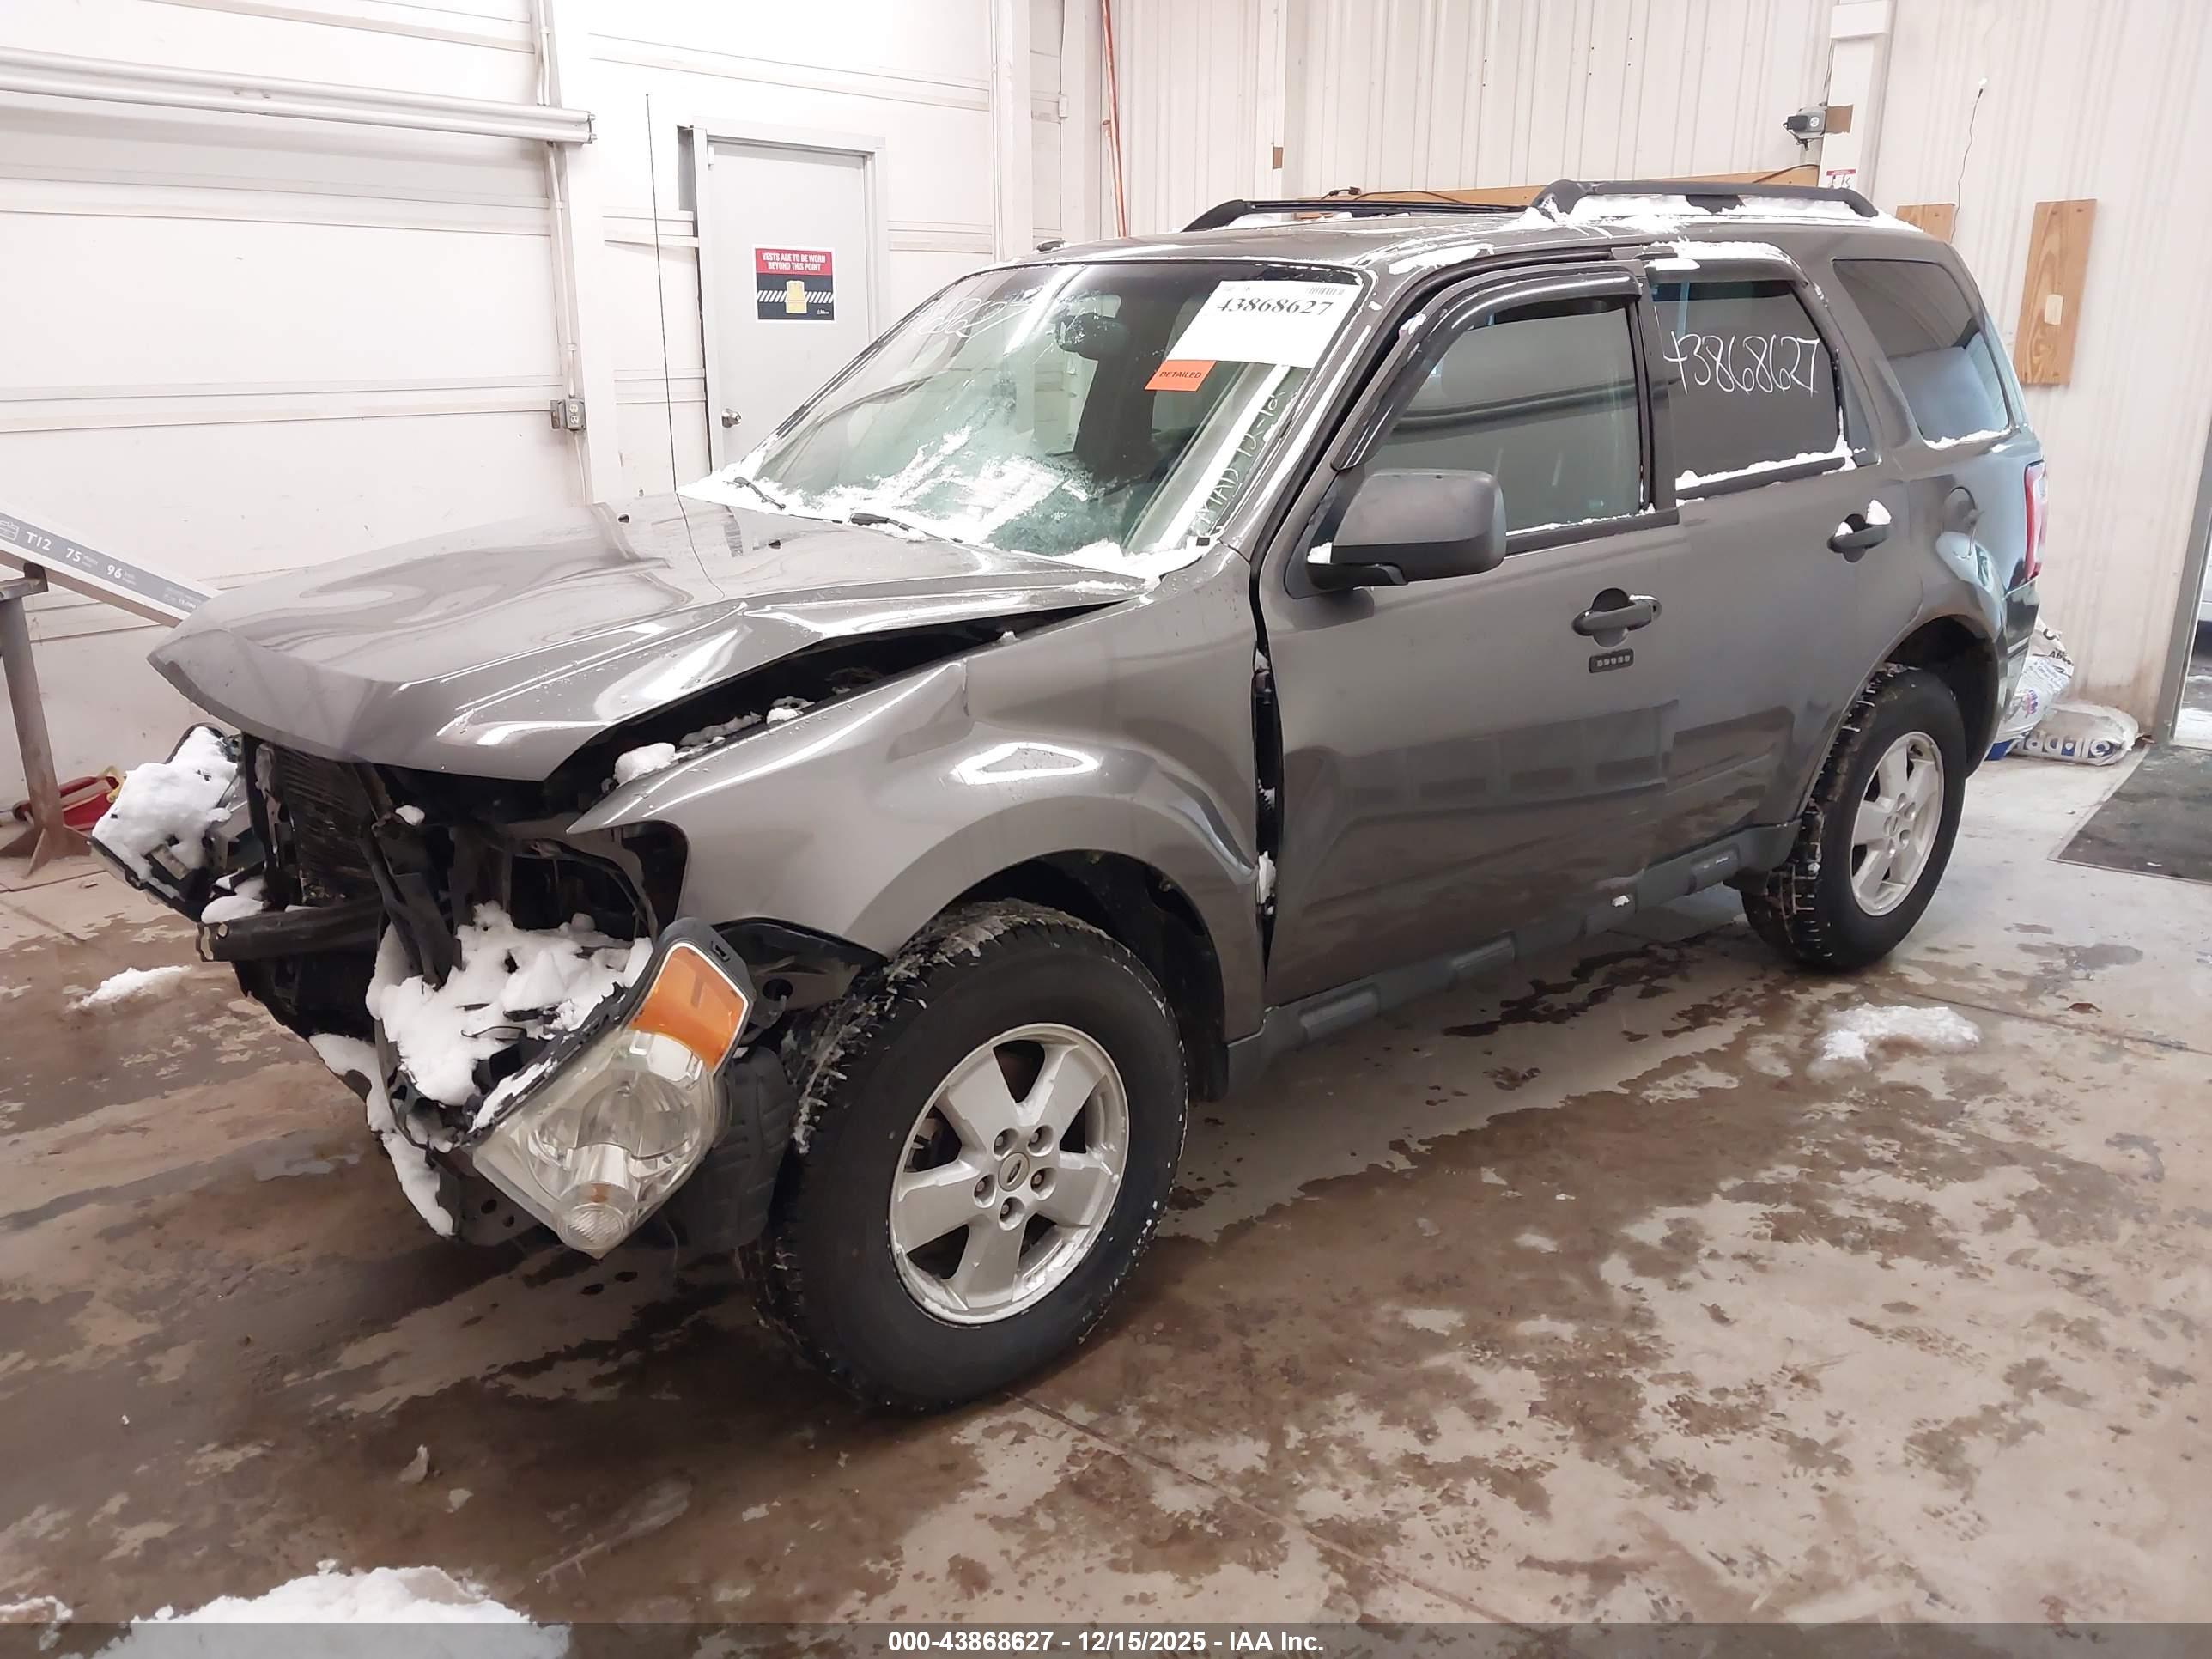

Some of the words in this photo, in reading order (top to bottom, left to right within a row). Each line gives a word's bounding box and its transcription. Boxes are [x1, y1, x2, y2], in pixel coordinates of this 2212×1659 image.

[763, 252, 780, 261] VESTS
[809, 254, 825, 263] WORN
[768, 261, 790, 270] BEYOND
[792, 262, 804, 270] THIS
[805, 263, 821, 271] POINT
[1217, 297, 1334, 315] 43868627
[1662, 330, 1821, 398] 43868627
[1159, 370, 1202, 380] DETAILED
[27, 531, 52, 551] T12
[64, 547, 82, 562] 75
[106, 564, 123, 579] 96
